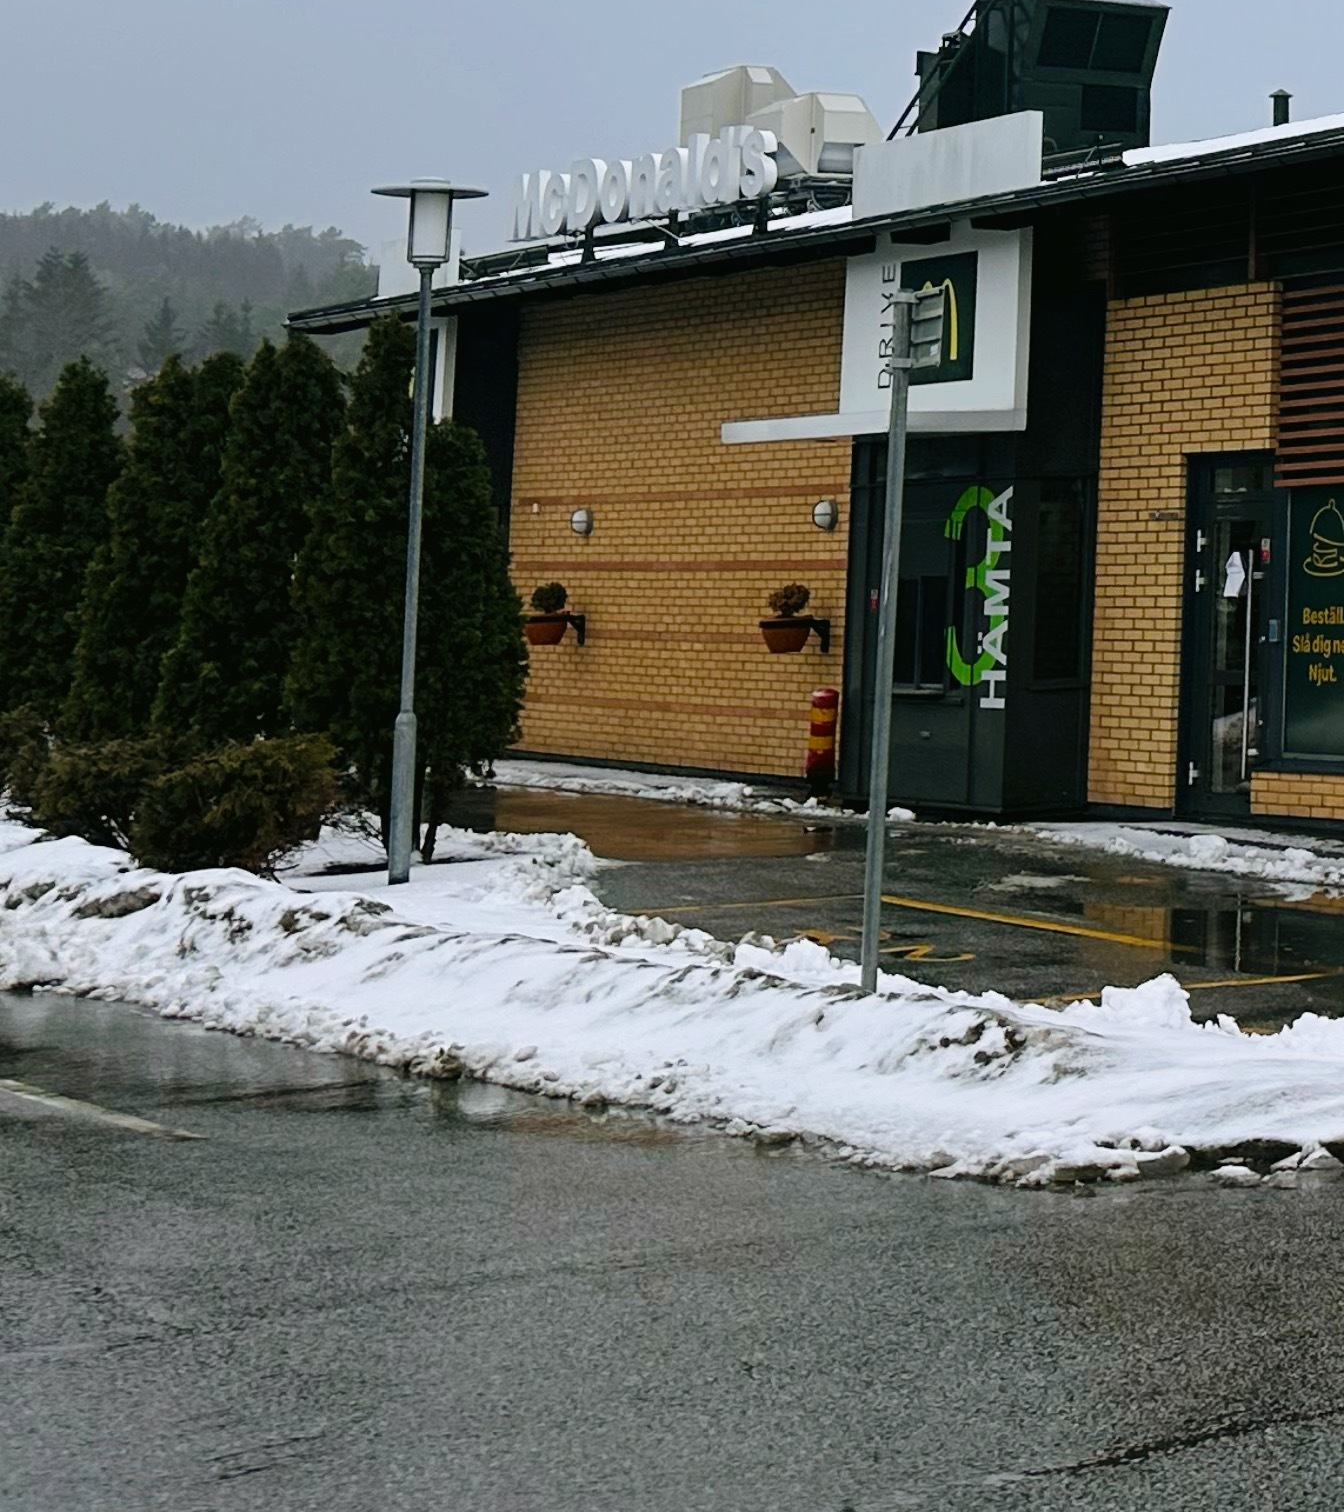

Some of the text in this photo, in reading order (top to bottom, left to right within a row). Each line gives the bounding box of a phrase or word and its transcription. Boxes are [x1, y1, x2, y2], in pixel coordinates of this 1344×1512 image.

[512, 125, 778, 241] McDonald's
[977, 486, 1014, 709] HÄMTA
[1292, 632, 1311, 654] Slå
[1312, 634, 1332, 658] dig
[1308, 662, 1338, 687] Njut.
